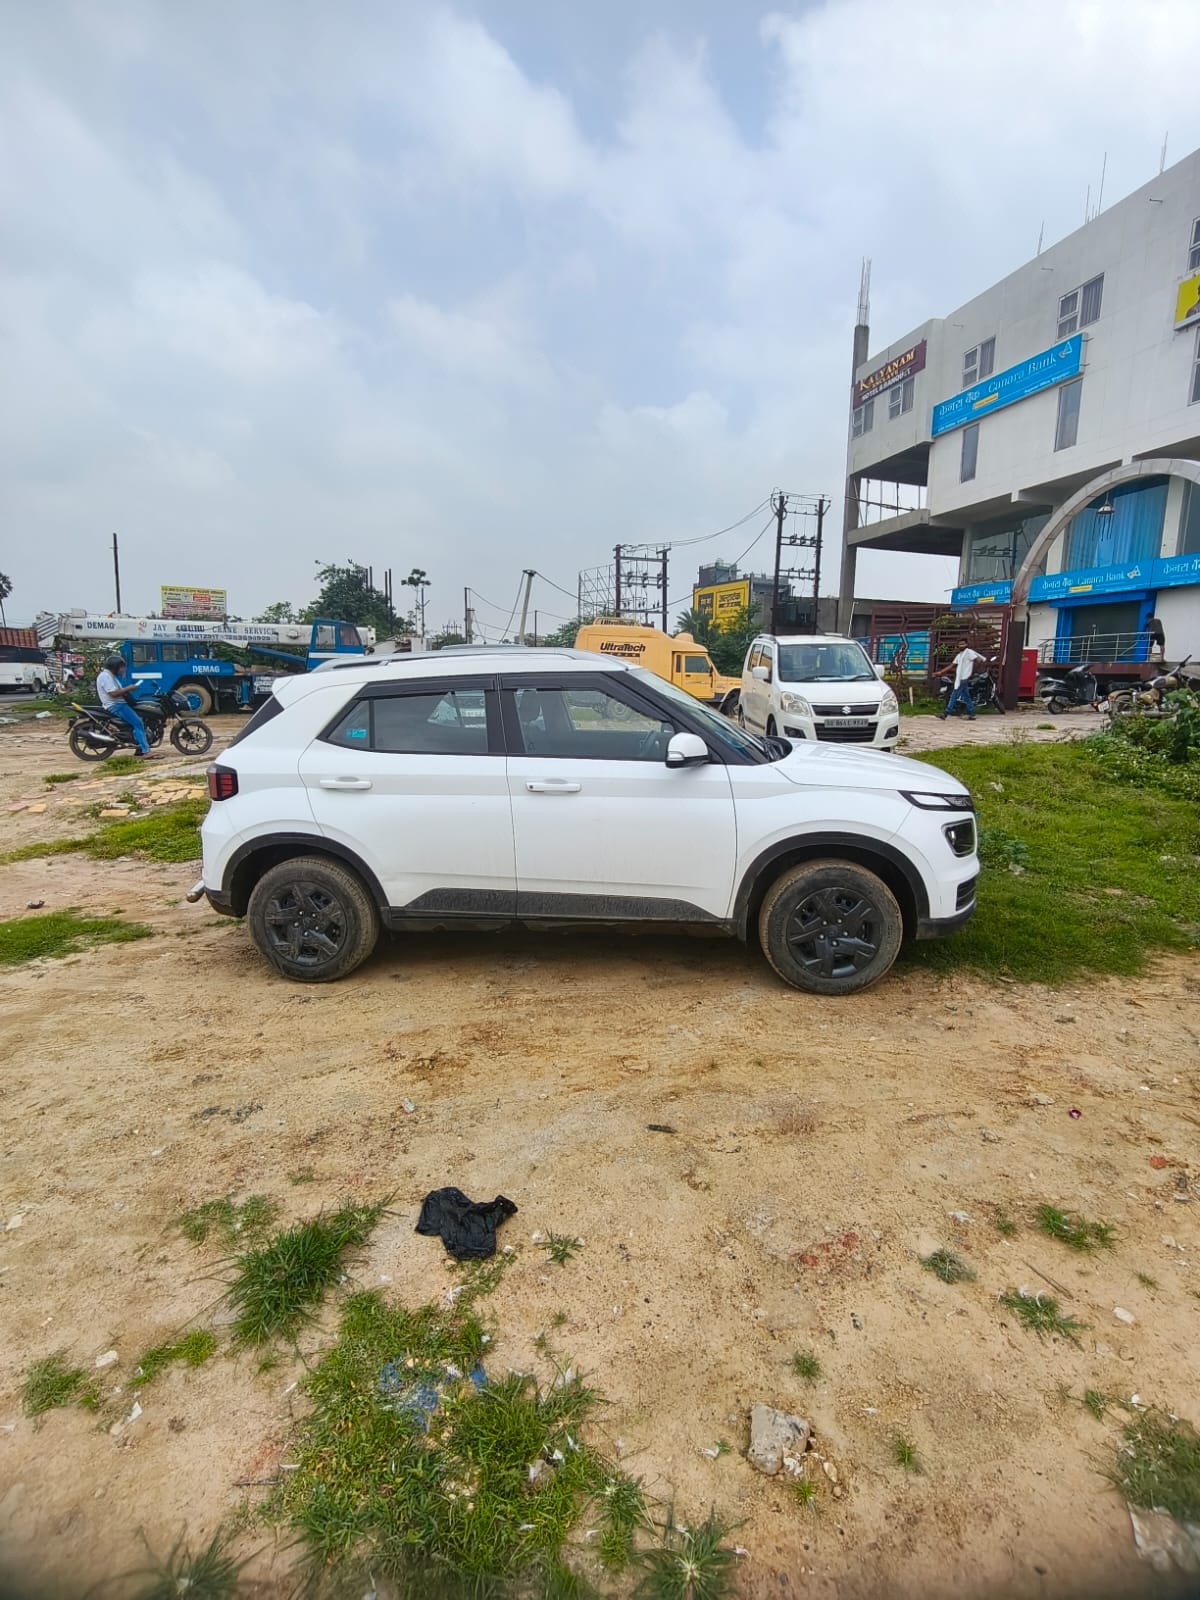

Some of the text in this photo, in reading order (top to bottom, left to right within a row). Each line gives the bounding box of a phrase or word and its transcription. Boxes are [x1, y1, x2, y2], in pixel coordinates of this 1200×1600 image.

[988, 370, 1025, 393] Canara
[1028, 352, 1057, 375] Bank
[1077, 569, 1124, 585] Canara Bank
[87, 622, 115, 630] DEMAG
[153, 623, 167, 631] JAY
[600, 642, 646, 652] UltraTech
[192, 665, 220, 673] DEMAG
